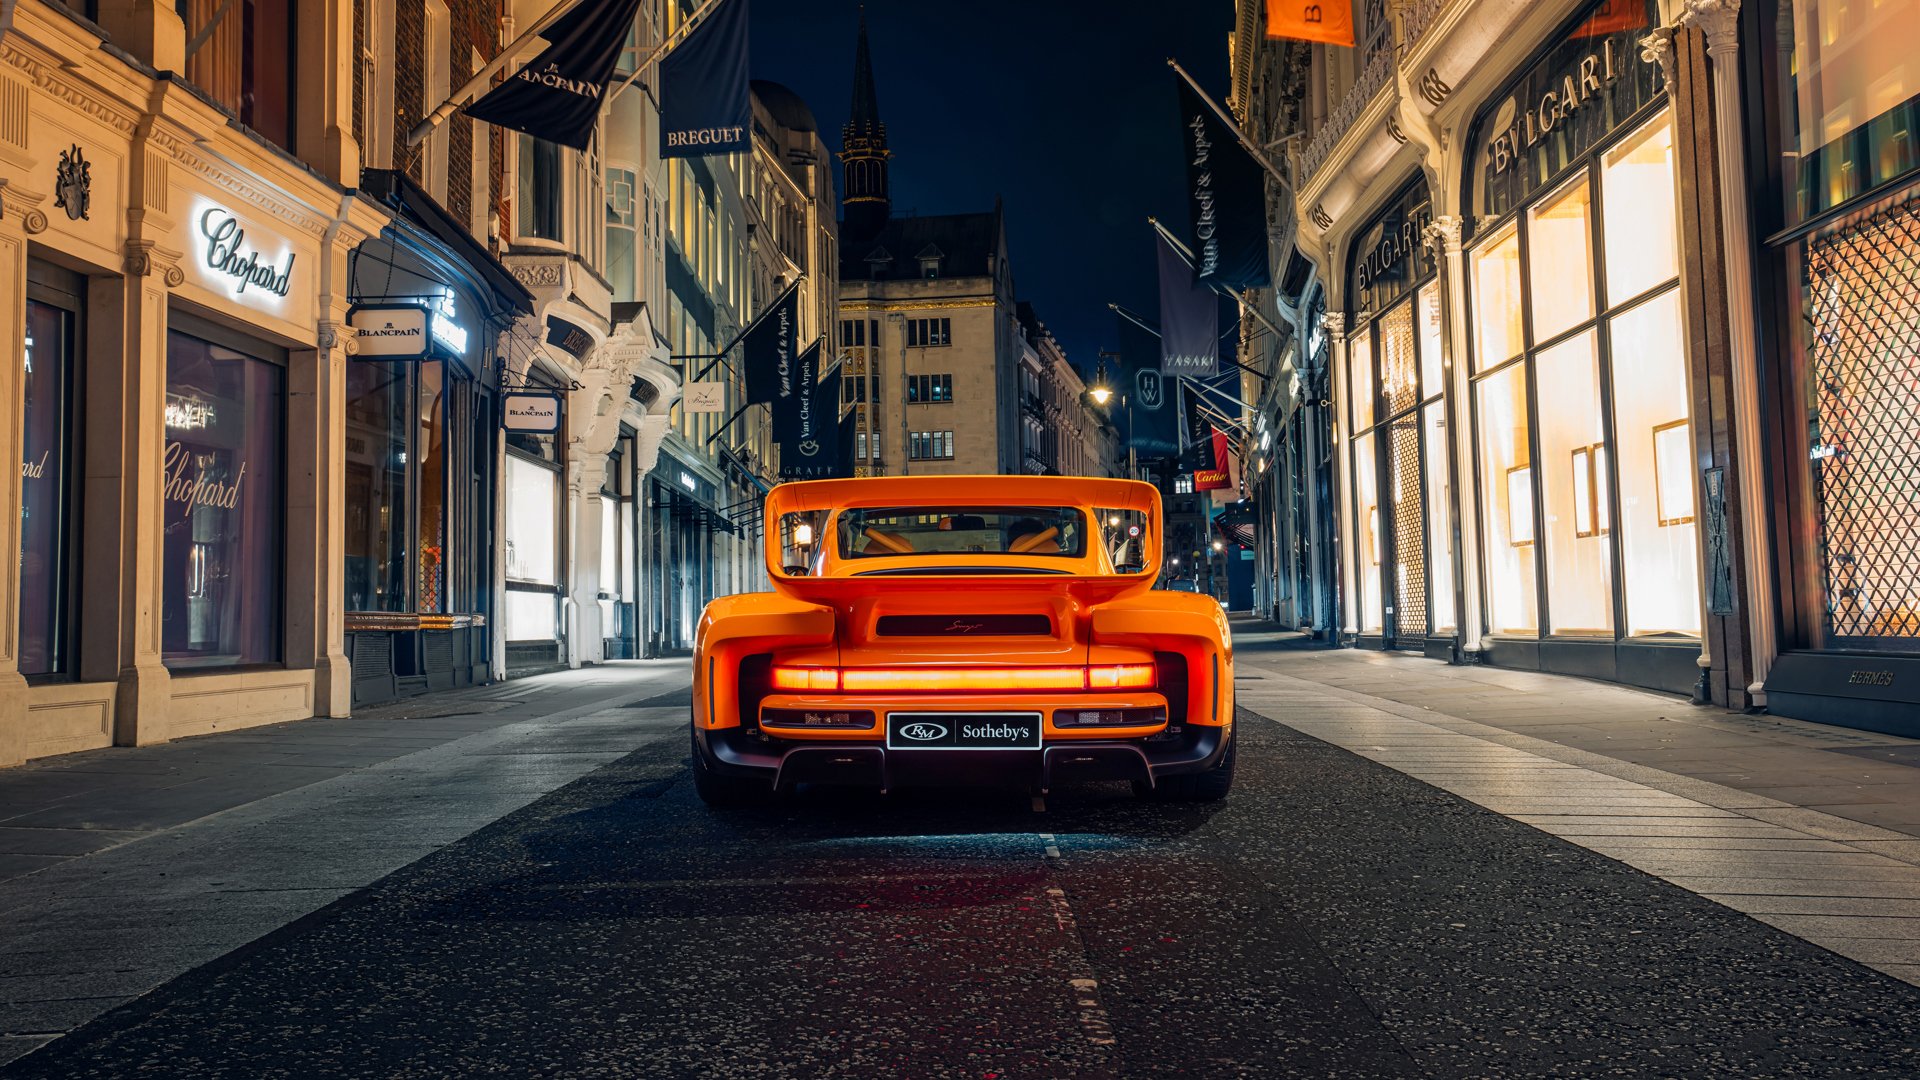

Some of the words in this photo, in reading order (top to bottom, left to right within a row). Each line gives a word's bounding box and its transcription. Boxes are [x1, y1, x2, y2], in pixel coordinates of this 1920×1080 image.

[518, 69, 602, 99] ANCPAIN
[1418, 67, 1452, 107] 168
[1494, 37, 1616, 174] BVLGARI
[667, 126, 743, 146] BREGUET
[1189, 115, 1212, 167] Arpels
[1386, 116, 1408, 145] 16
[1197, 172, 1211, 187] &
[1195, 188, 1216, 240] Cleef
[1311, 203, 1334, 231] 168
[200, 208, 296, 297] Chopard
[1200, 238, 1218, 278] Van
[1358, 213, 1420, 291] BVLGARI
[358, 327, 420, 337] BLANCPAIN
[778, 307, 790, 337] Arpels
[780, 339, 788, 348] &
[780, 376, 791, 398] Van
[801, 361, 812, 387] Arpels
[509, 409, 553, 417] BLANCPAIN
[800, 397, 809, 420] Cleef
[801, 421, 810, 439] Van
[784, 465, 833, 476] GRAFF
[1196, 470, 1228, 483] Cartier
[962, 723, 1029, 742] Sotheby's
